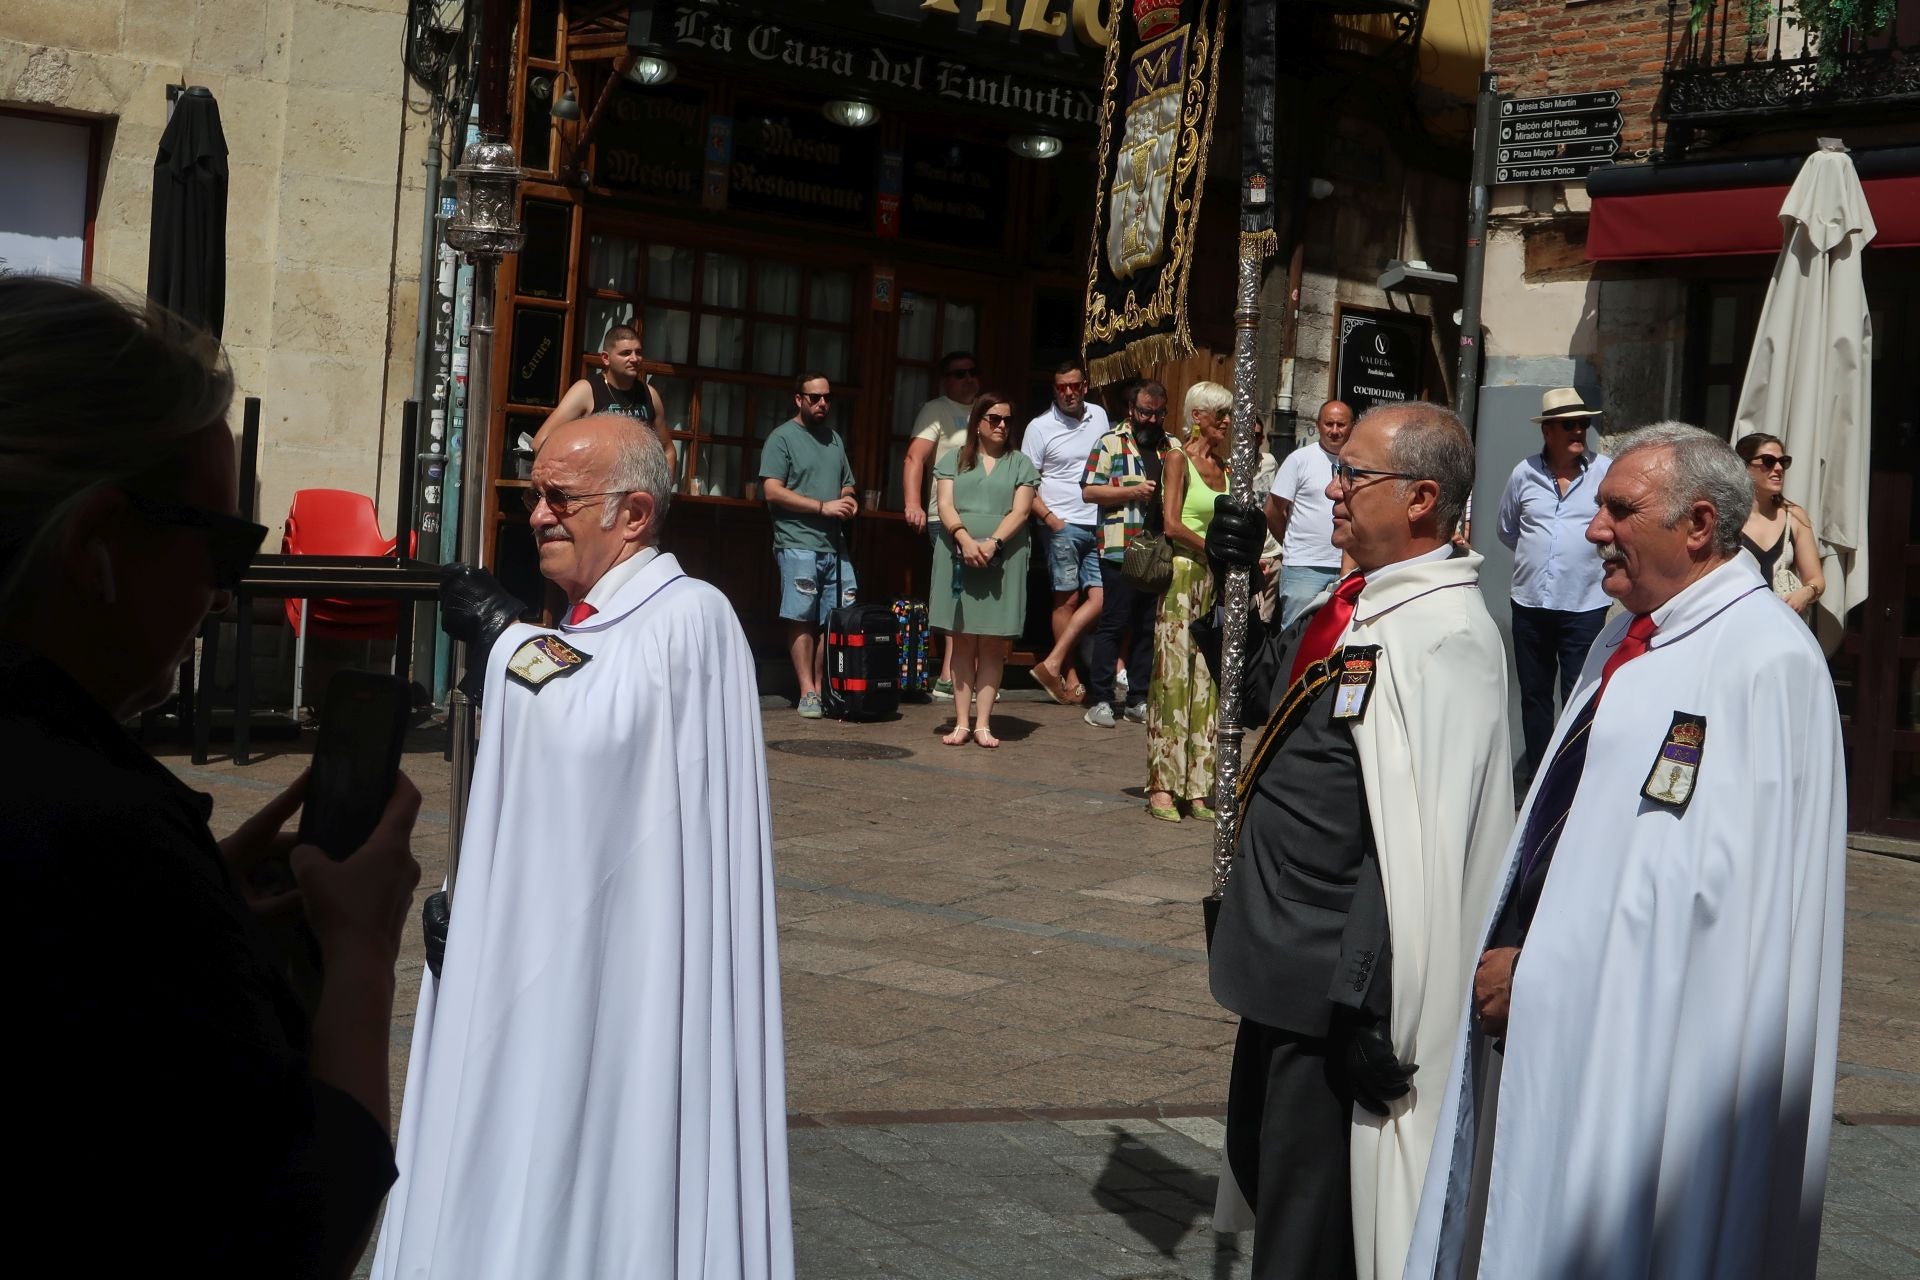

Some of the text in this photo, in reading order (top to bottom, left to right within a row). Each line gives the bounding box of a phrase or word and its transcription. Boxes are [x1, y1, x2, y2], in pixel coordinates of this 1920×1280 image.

[674, 7, 732, 51] La
[748, 24, 853, 77] Casa
[867, 48, 923, 90] del
[1516, 102, 1538, 113] Iglesia
[1540, 100, 1553, 109] San
[1554, 98, 1577, 108] Martín
[1515, 121, 1540, 131] Balcón
[1541, 120, 1553, 129] del
[1554, 119, 1579, 128] Pueblo
[1514, 126, 1587, 140] Mirador de la ciudad
[1513, 149, 1532, 158] Plaza
[1533, 148, 1555, 158] Mayor
[606, 149, 691, 191] Mesón
[1511, 169, 1529, 178] Torre
[1530, 168, 1539, 177] de
[1540, 167, 1552, 176] los
[1552, 166, 1575, 175] Ponce
[732, 162, 863, 210] Restaurante
[521, 336, 551, 379] Carnes
[1353, 385, 1405, 400] COCIDO LEONÉS
